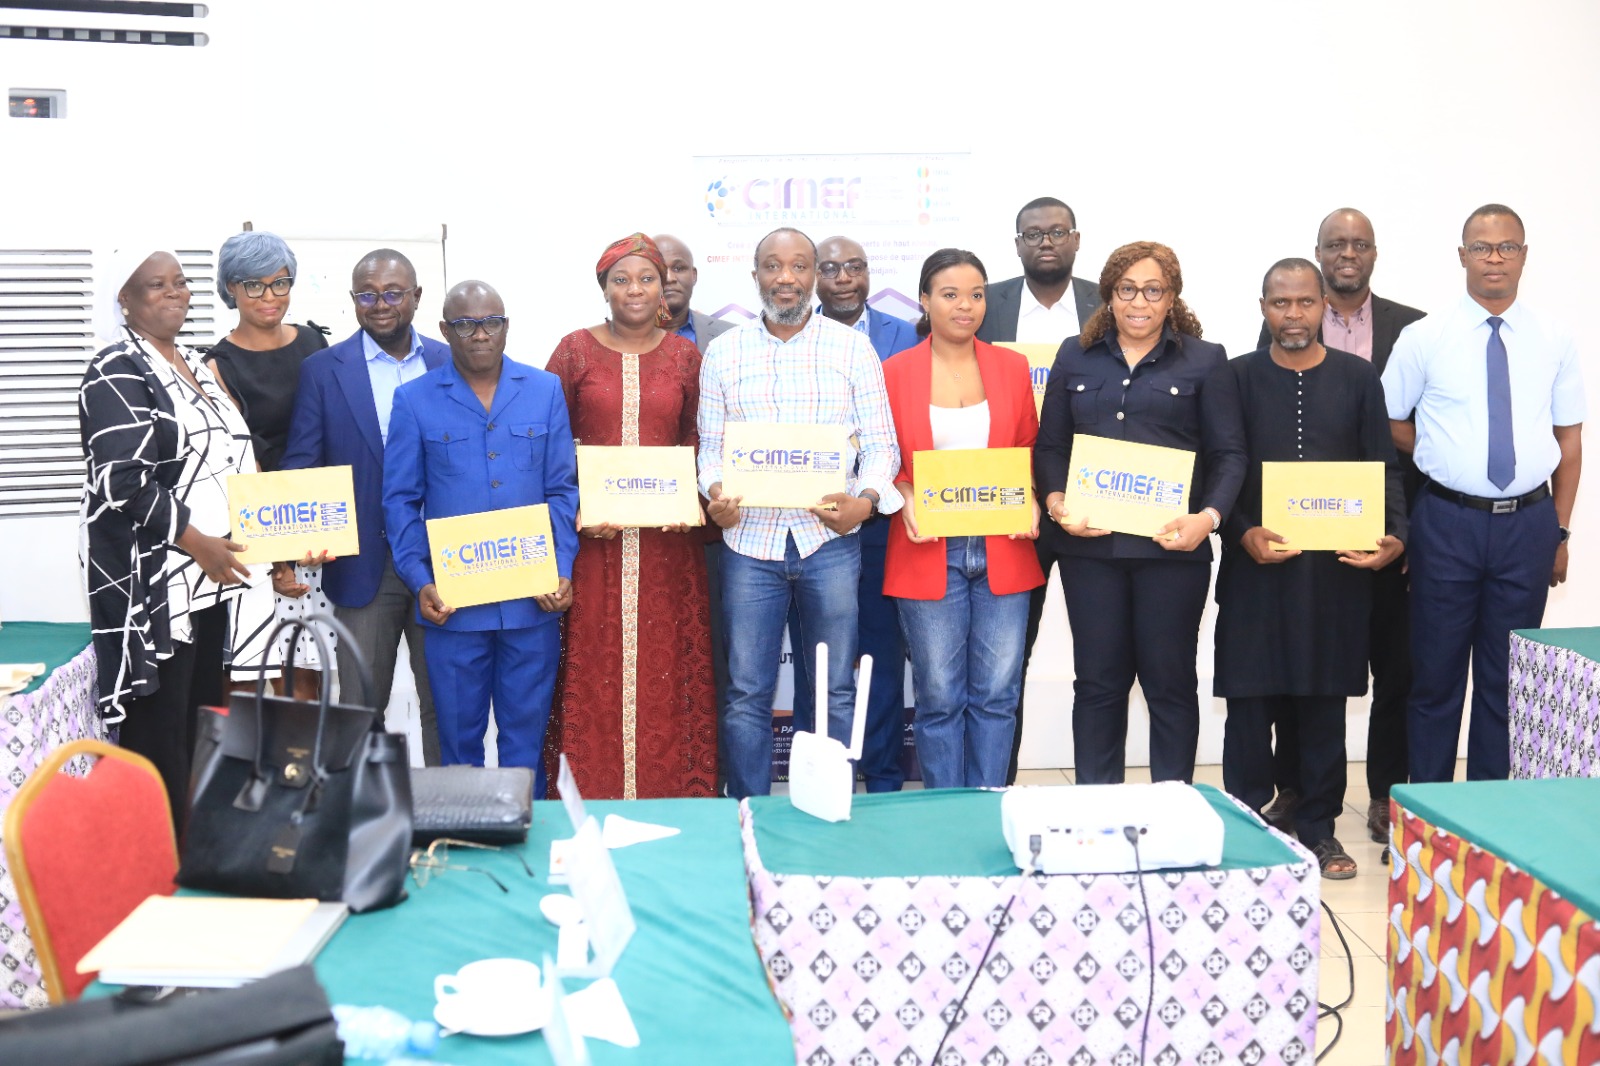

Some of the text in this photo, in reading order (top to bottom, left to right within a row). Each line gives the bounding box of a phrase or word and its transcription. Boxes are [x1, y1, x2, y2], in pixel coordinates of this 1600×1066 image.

[742, 177, 861, 210] CIMEF
[749, 211, 856, 220] INTERNATIONAL
[707, 255, 730, 263] CIMEF
[890, 253, 899, 261] de
[749, 449, 811, 465] CIMEF
[617, 477, 658, 489] CIMEF
[1095, 469, 1156, 496] CIMEF
[940, 486, 998, 503] CIMEF
[1300, 498, 1342, 510] CIMEF
[257, 501, 318, 527] CIMEF
[459, 536, 518, 564] CIMEF
